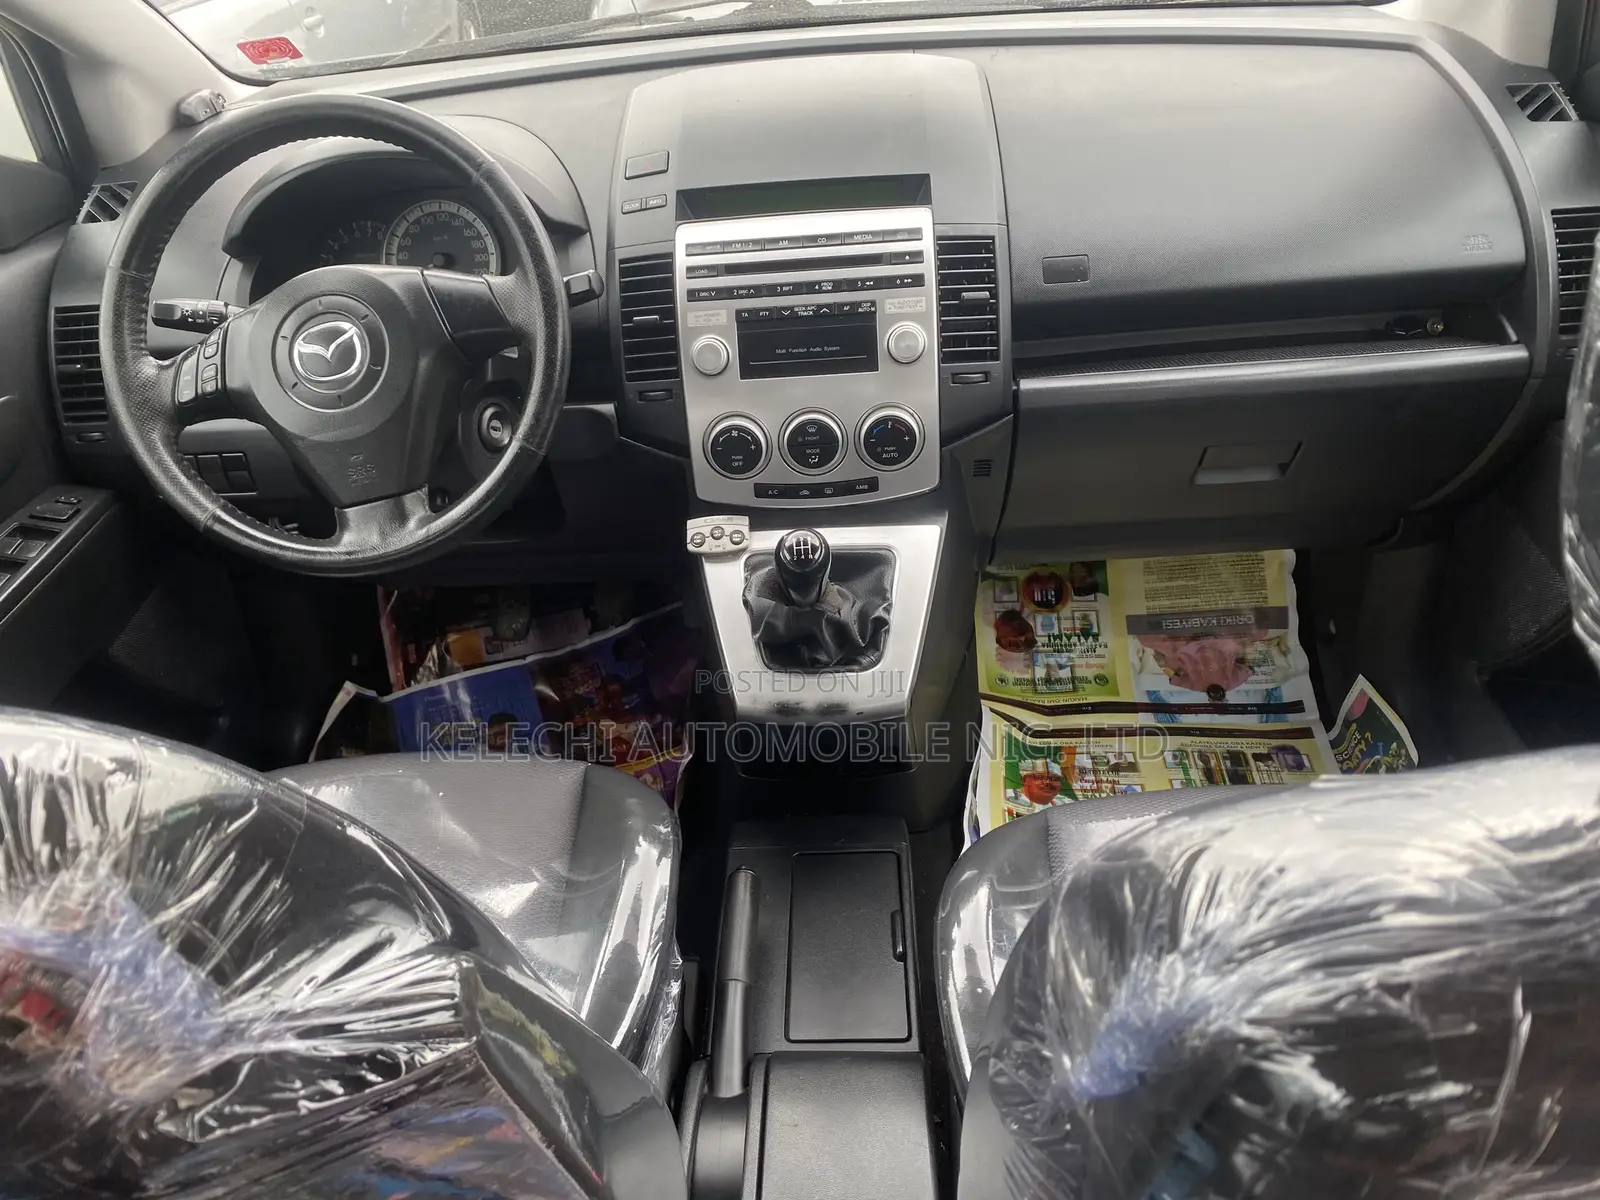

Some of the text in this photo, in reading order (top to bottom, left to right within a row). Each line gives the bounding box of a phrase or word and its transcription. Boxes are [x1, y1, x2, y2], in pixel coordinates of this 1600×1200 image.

[420, 216, 434, 227] 100
[436, 213, 450, 222] 120
[451, 218, 465, 227] 140
[408, 224, 420, 234] 80
[463, 227, 477, 237] 160
[400, 237, 412, 247] 60
[853, 233, 873, 241] MEDIA
[471, 239, 485, 248] 180
[397, 251, 409, 261] 40
[474, 252, 489, 262] 200
